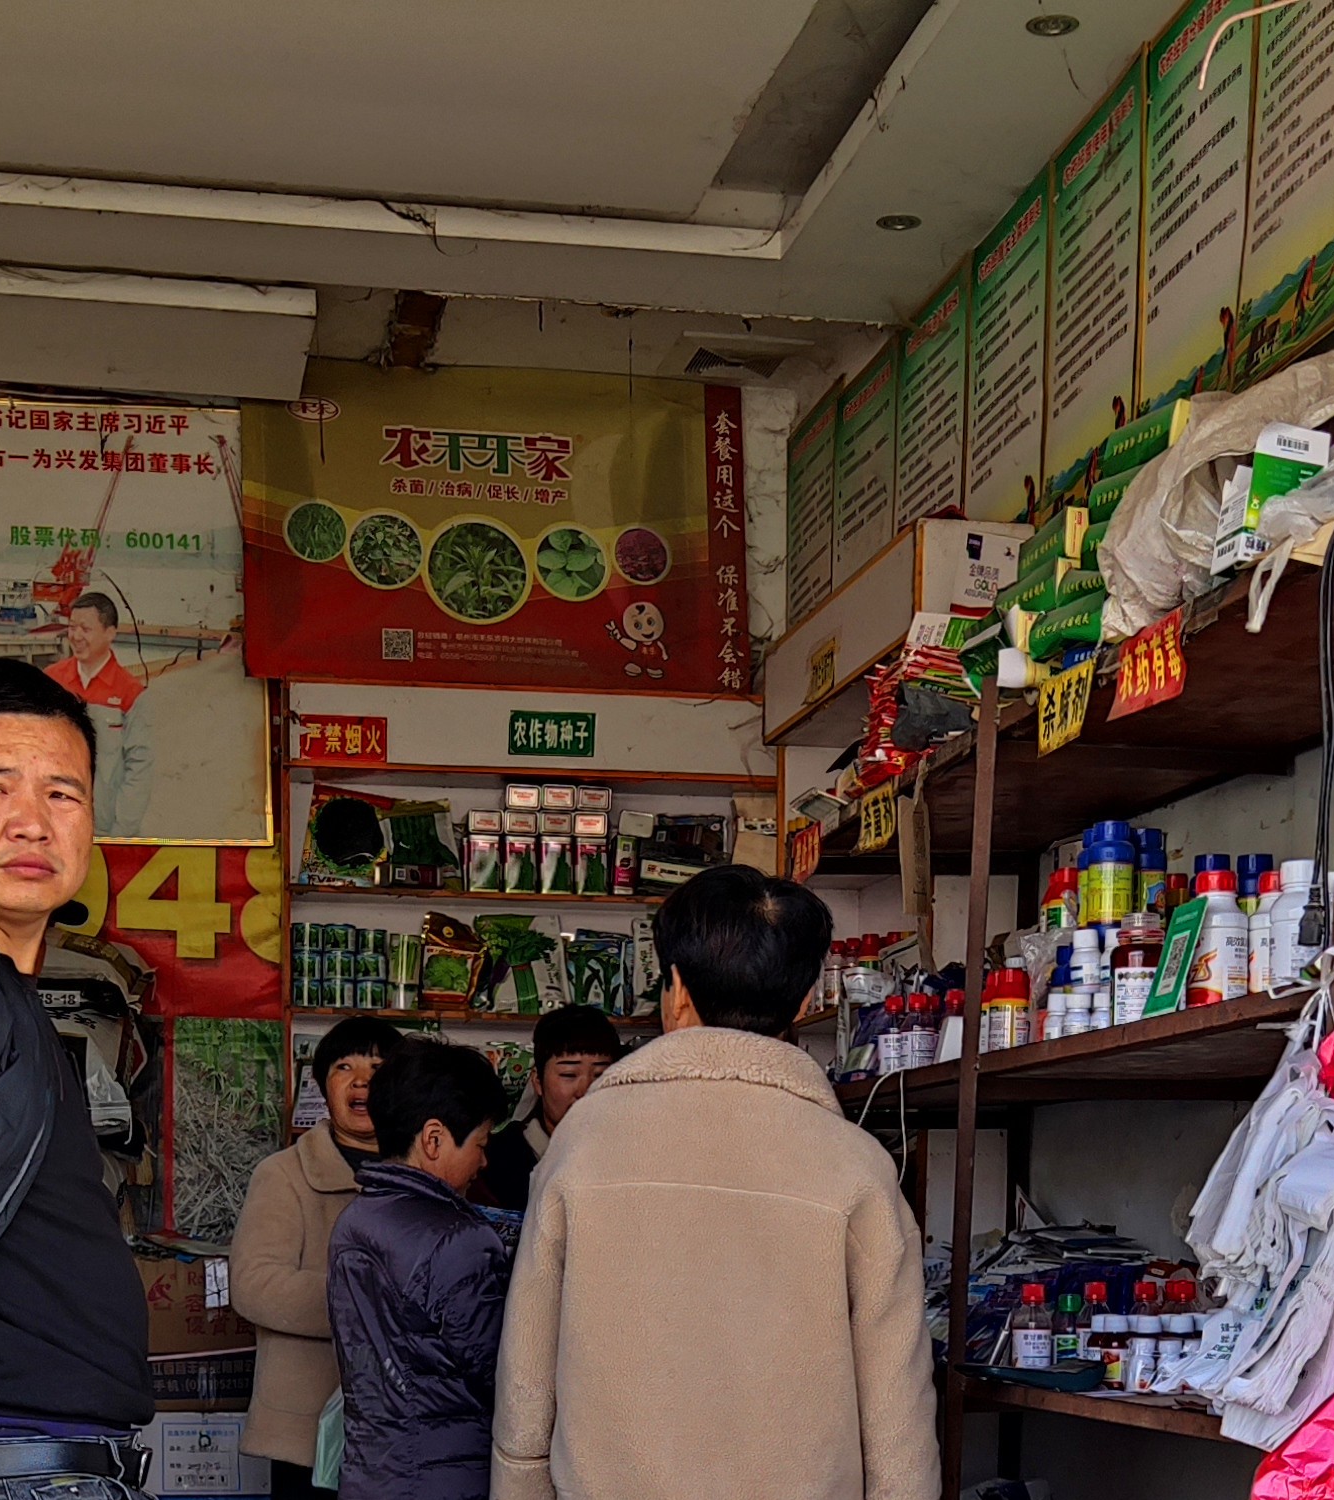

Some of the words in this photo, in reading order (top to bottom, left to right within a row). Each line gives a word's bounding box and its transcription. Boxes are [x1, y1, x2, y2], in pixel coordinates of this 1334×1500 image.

[711, 409, 740, 540] 套餐用这个
[715, 564, 745, 691] 保准不会错
[1120, 622, 1183, 702] 农药有毒
[301, 721, 383, 754] 严禁烟火
[513, 721, 589, 750] 农作物种子
